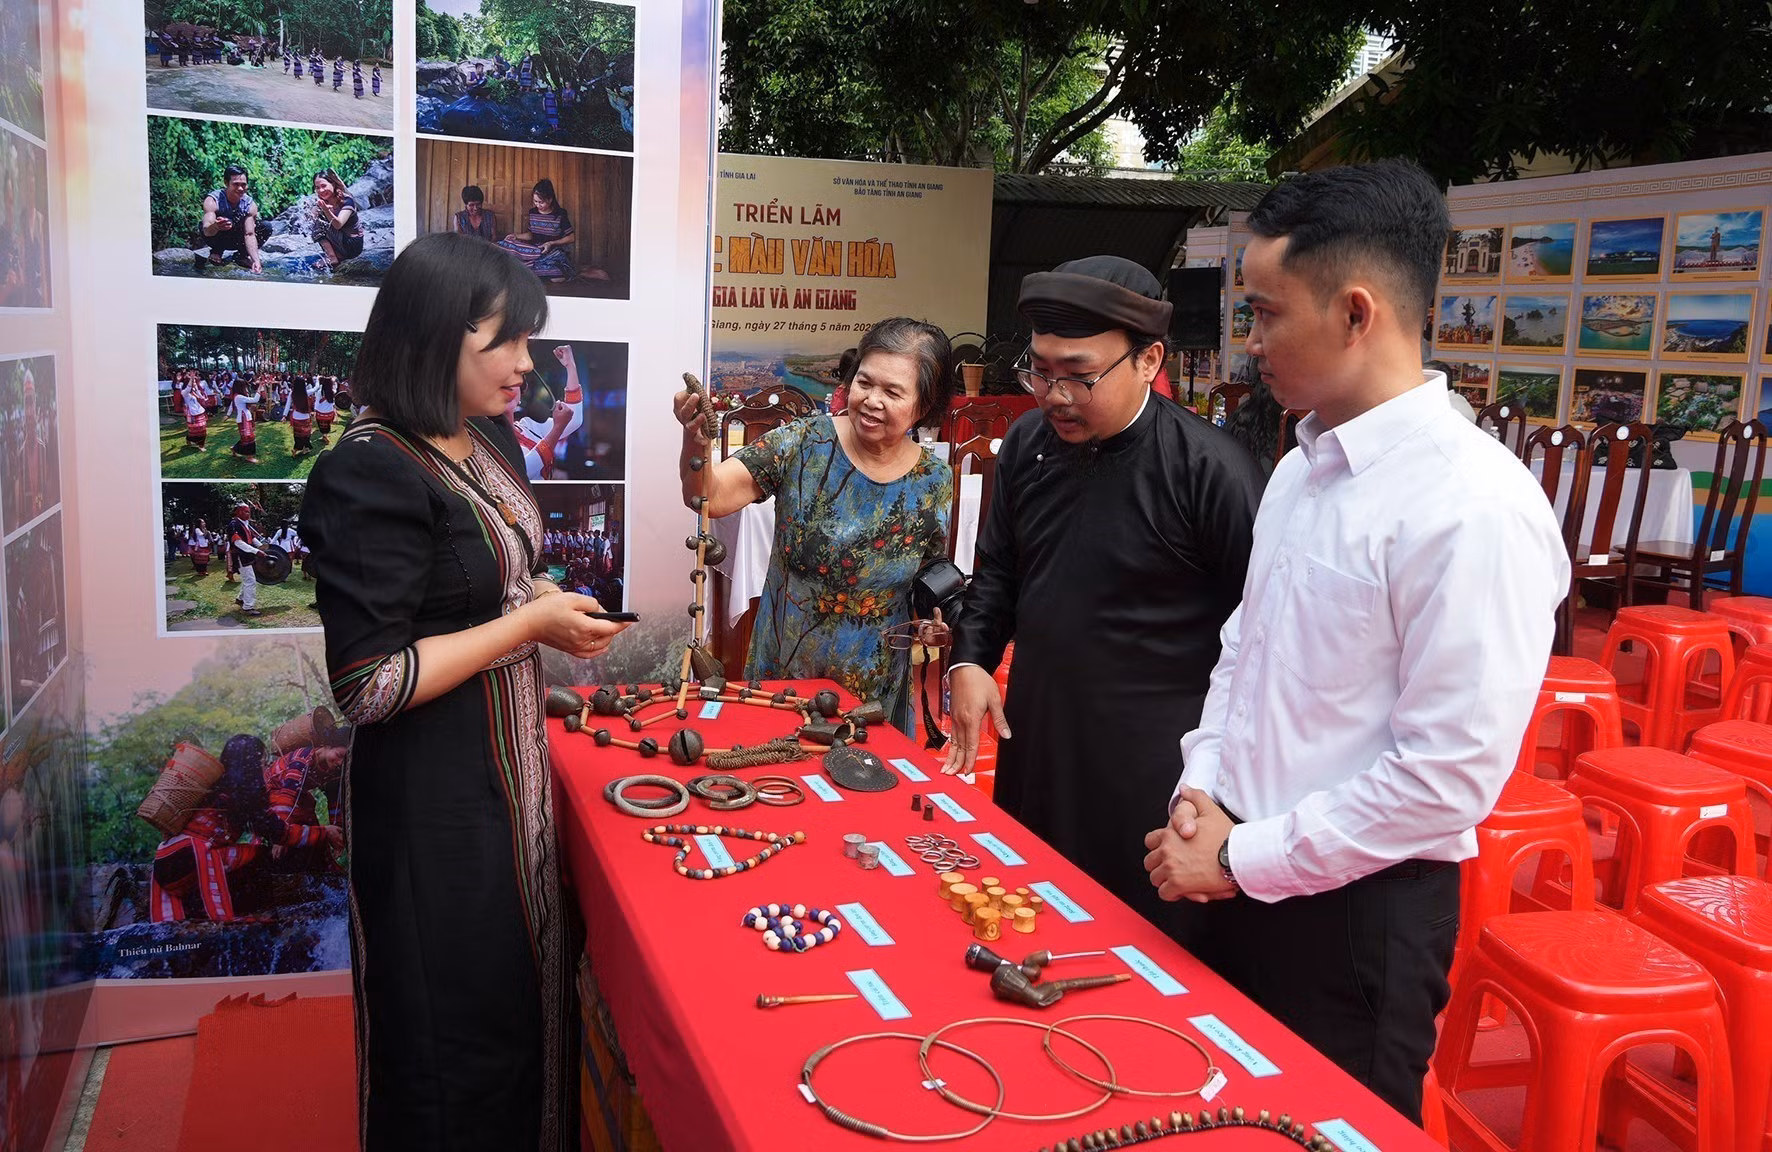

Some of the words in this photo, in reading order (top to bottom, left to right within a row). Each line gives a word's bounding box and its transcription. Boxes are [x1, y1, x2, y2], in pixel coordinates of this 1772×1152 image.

[833, 177, 841, 185] SỞ
[842, 178, 854, 186] VĂN
[855, 178, 867, 187] HÓA
[868, 178, 876, 187] VÀ
[889, 181, 903, 189] THAO
[927, 183, 944, 191] GIANG
[854, 187, 867, 196] BẢO
[867, 188, 882, 197] TÀNG
[906, 191, 923, 199] GIANG
[733, 198, 793, 224] TRIỂN
[800, 203, 842, 226] LÃM
[728, 232, 785, 275] MÀU
[790, 236, 843, 277] VĂN
[847, 237, 897, 278] HÓA
[713, 286, 738, 308] GIA
[741, 287, 766, 309] LAI
[769, 285, 789, 309] VÀ
[793, 288, 812, 310] AN
[815, 289, 857, 311] GIANG
[744, 320, 772, 332] ngày
[773, 321, 787, 330] 27
[788, 321, 818, 333] tháng
[820, 323, 827, 332] 5
[829, 322, 851, 332] năm
[118, 945, 147, 957] Thiếu
[150, 945, 163, 953] nữ
[165, 942, 202, 952] Bahnar
